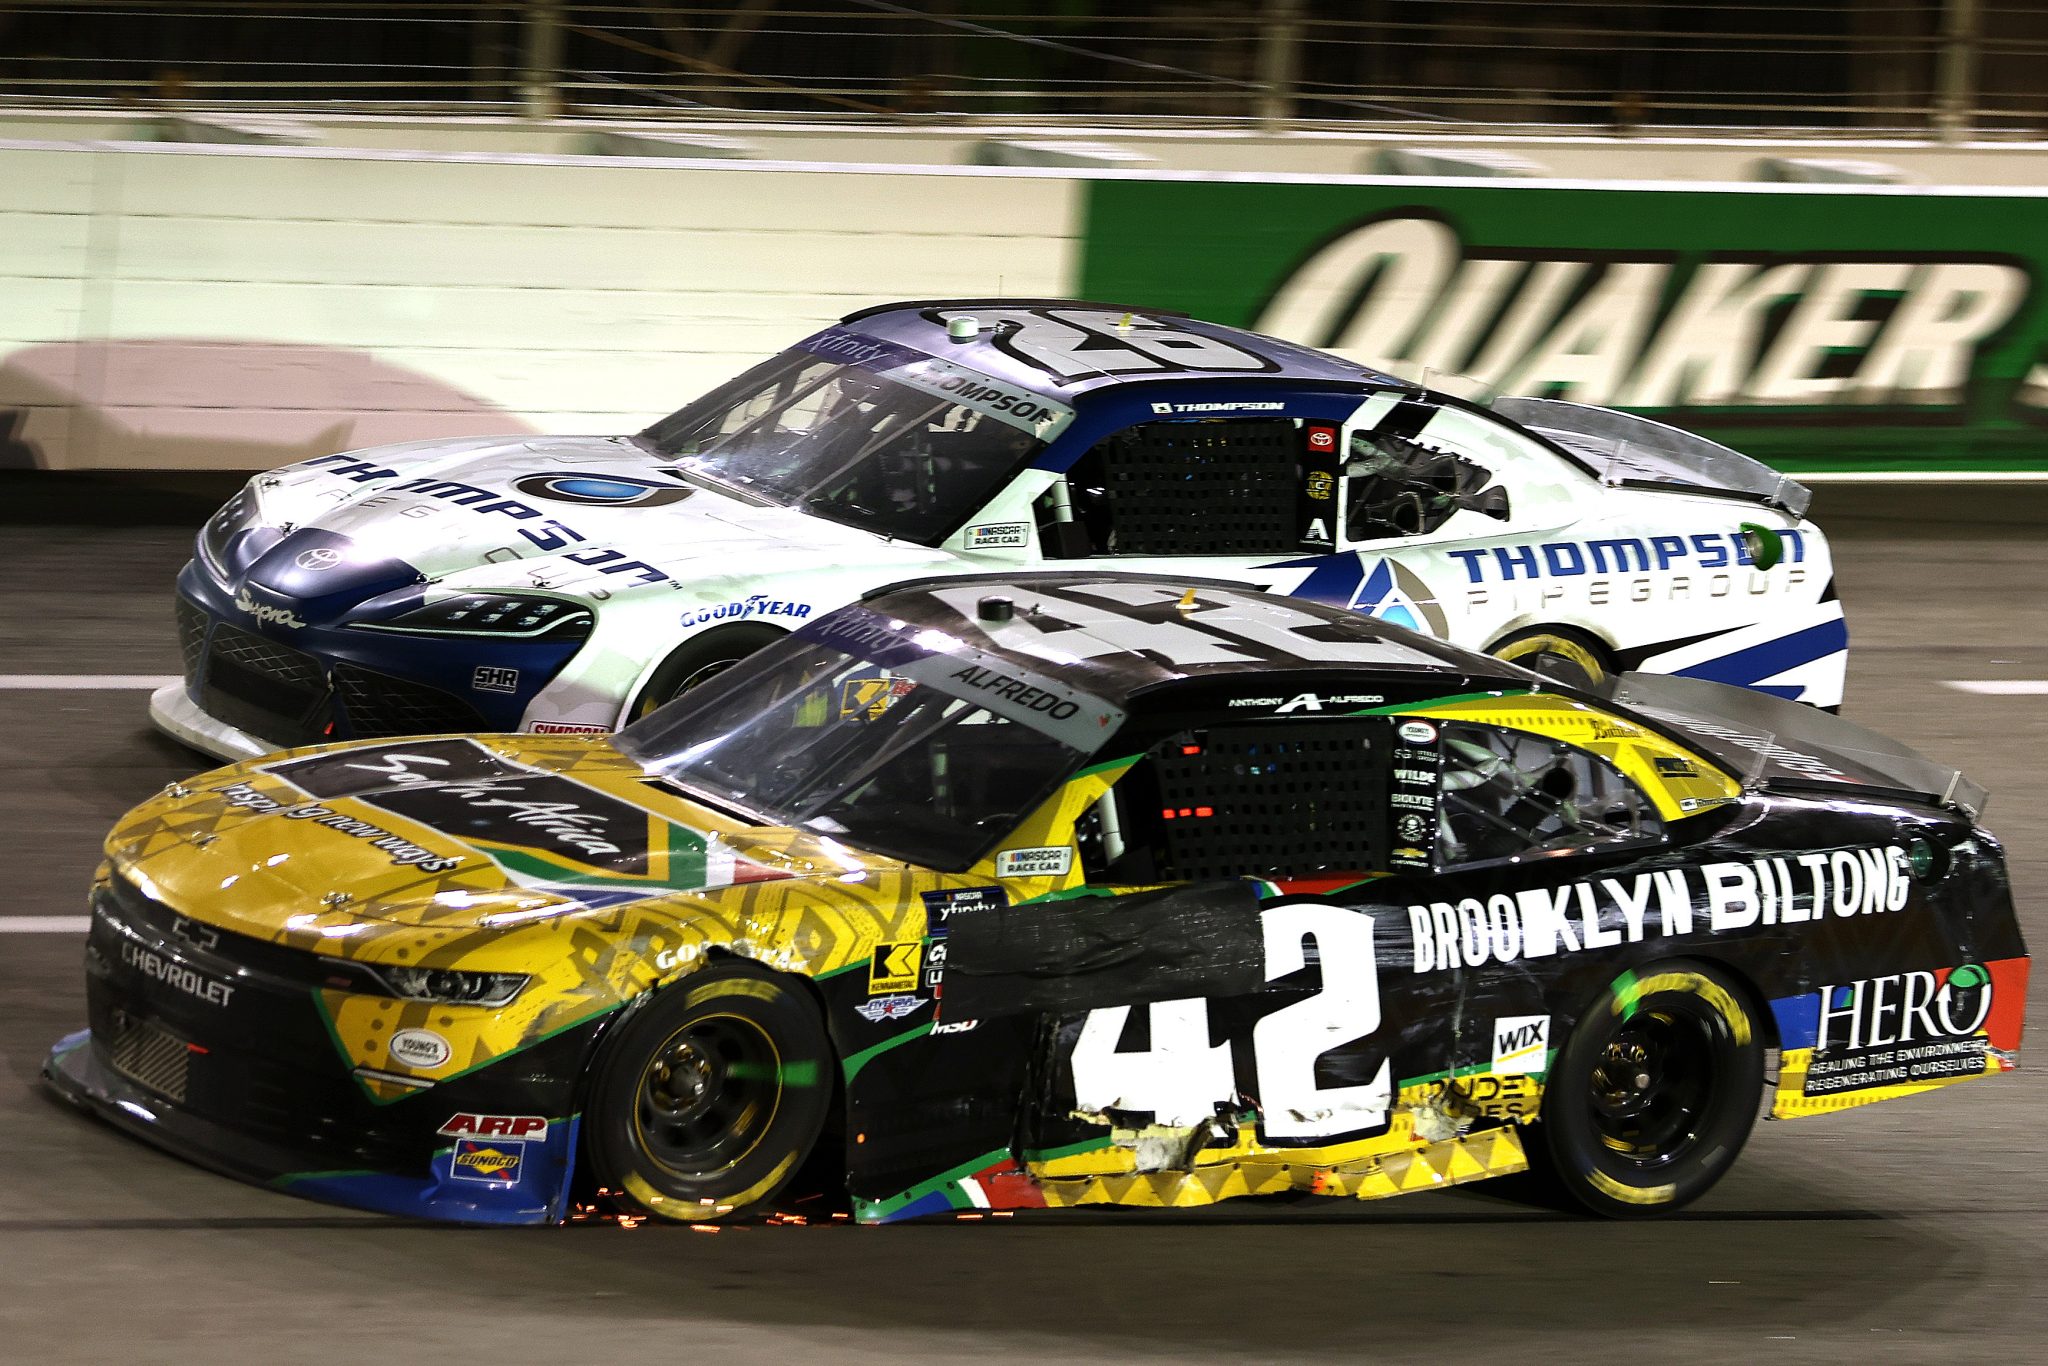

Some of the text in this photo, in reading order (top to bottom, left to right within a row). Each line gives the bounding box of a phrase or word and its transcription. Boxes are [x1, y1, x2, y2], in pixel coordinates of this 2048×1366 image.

[1250, 213, 2030, 408] QUAKER
[808, 333, 890, 366] xfinity
[911, 366, 1056, 424] OMPSON
[1174, 401, 1286, 413] THOMPSON
[974, 536, 1020, 545] RACE CAR
[985, 525, 1021, 536] NASCAR
[235, 588, 307, 629] Supra
[679, 600, 812, 628] GOODYEAR
[475, 667, 517, 686] SHR
[950, 665, 1081, 721] ALFREDO
[1228, 697, 1284, 707] ANTHONY
[1329, 695, 1385, 704] ALFREDO
[313, 814, 391, 839] new
[370, 836, 458, 873] ways
[1020, 850, 1062, 861] NASCAR
[1008, 862, 1060, 872] RACE CAR
[1407, 845, 1910, 974] BROOKLYN BILTONG
[121, 940, 236, 1007] CHEVROLET
[1070, 903, 1392, 1139] 42
[1817, 963, 1992, 1052] HERO
[1498, 1019, 1545, 1055] WIX
[1806, 1057, 1986, 1091] REGENERATING OURSELVES
[1869, 1051, 1895, 1066] THE
[441, 1114, 546, 1136] ARP
[461, 1154, 518, 1168] SUNOCO
